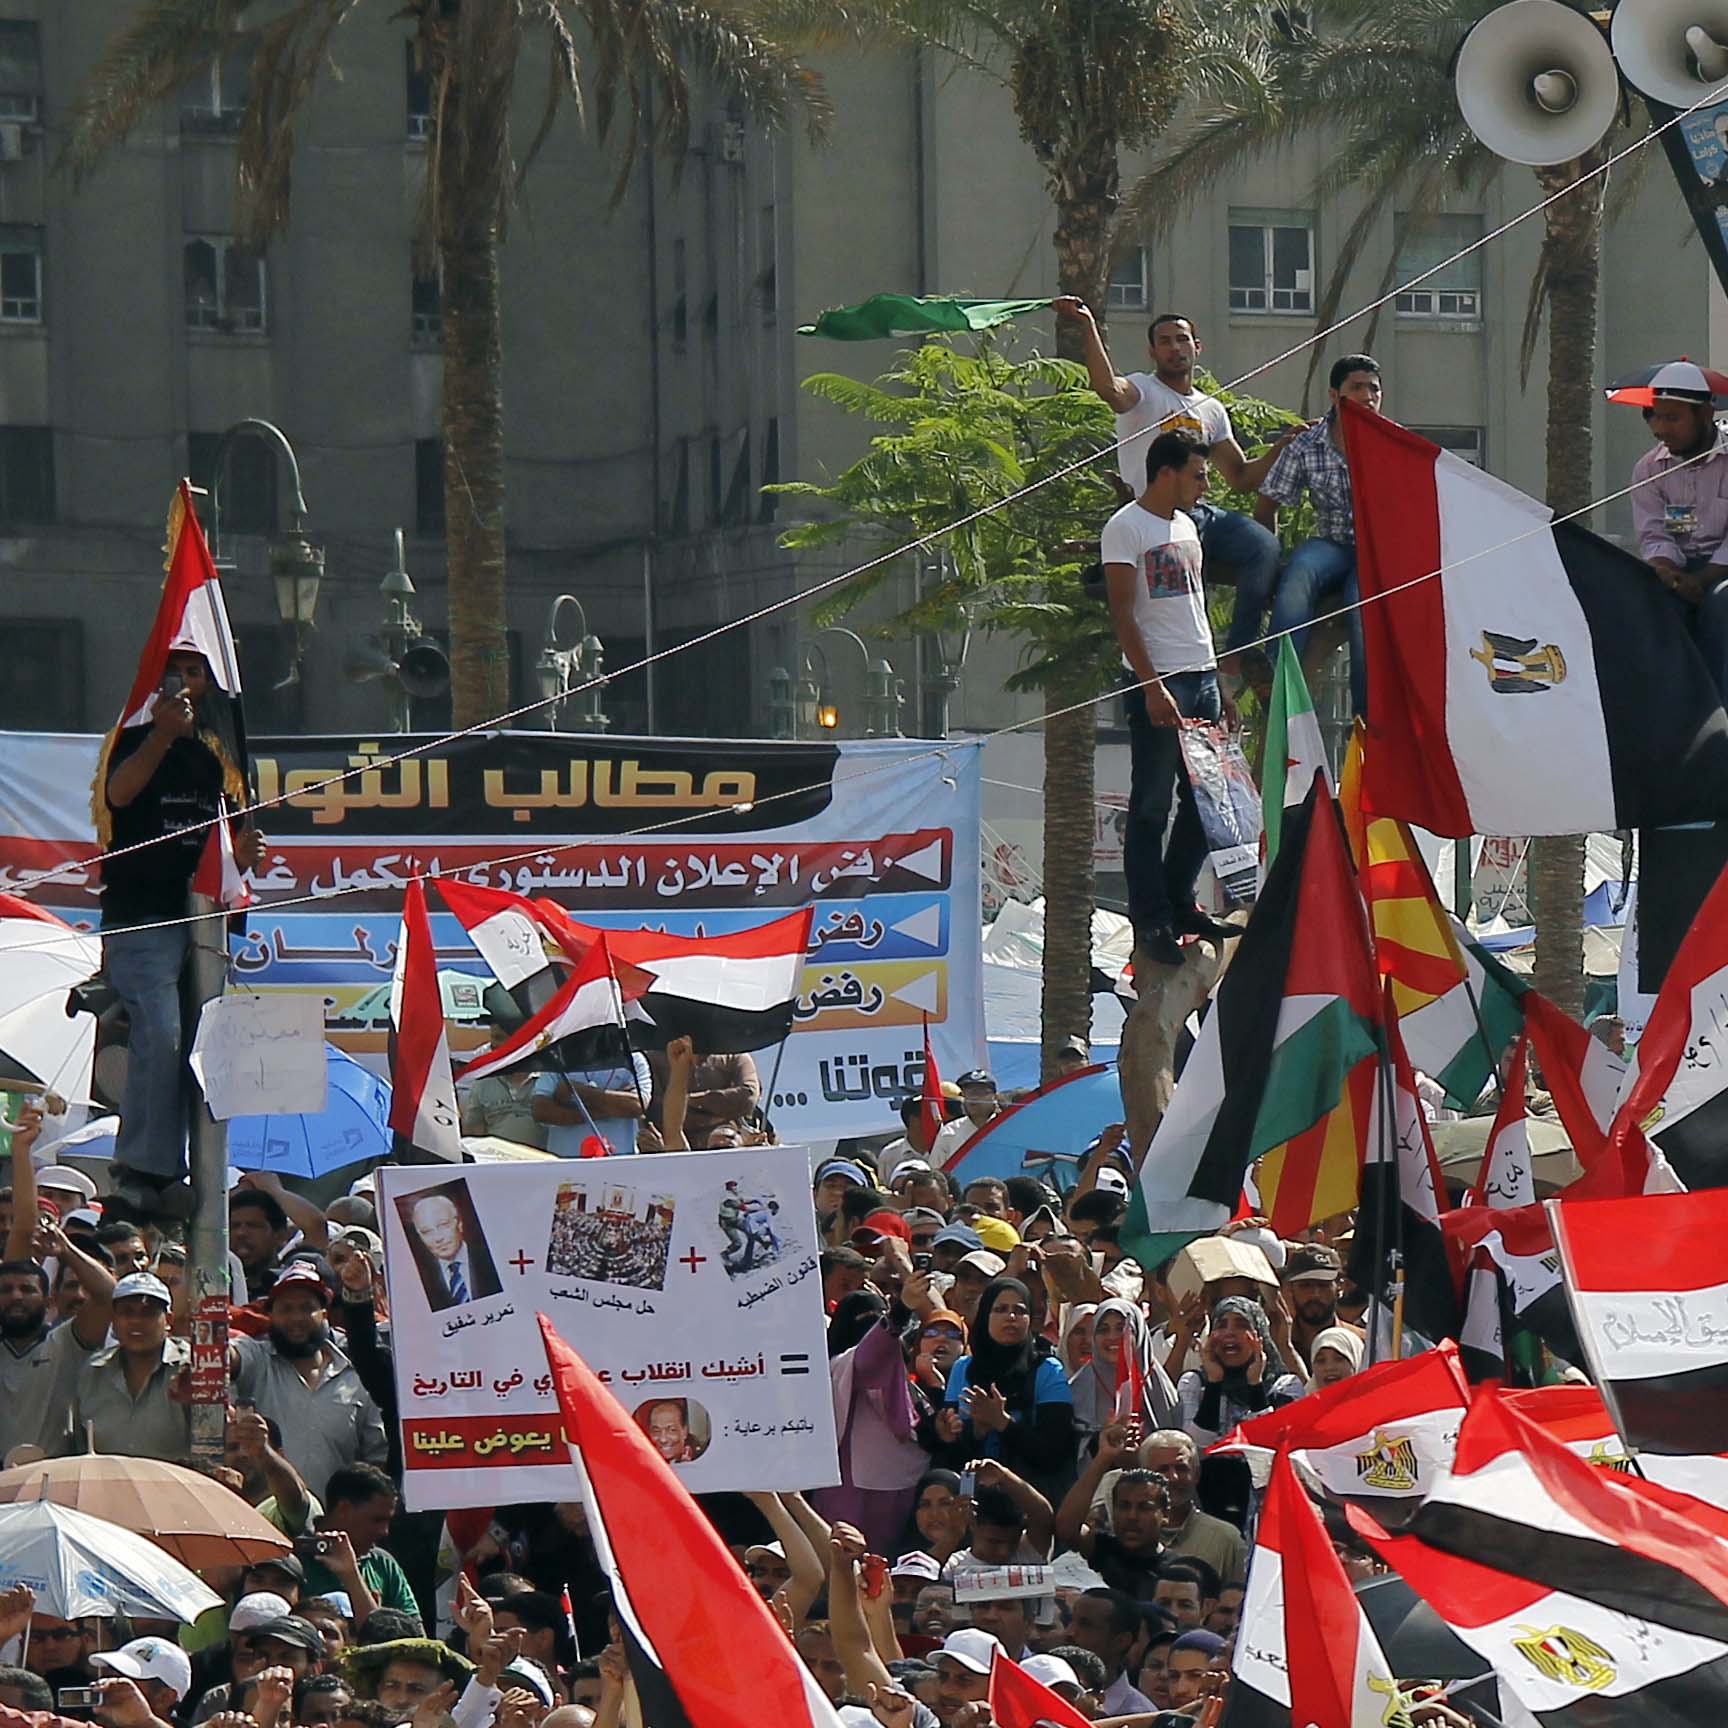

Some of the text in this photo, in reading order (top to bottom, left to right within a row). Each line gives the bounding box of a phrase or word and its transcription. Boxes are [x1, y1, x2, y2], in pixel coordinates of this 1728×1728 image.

[255, 742, 449, 824] الثوا
[484, 757, 757, 823] مطالب
[655, 852, 799, 897] الإعلان
[806, 911, 884, 951] رفض
[796, 972, 884, 1016] رفض
[786, 1255, 819, 1288] قانون
[548, 1284, 656, 1315] حل مجلس الشعب
[441, 1312, 478, 1338] شفيق
[620, 1360, 692, 1383] انقلاب
[701, 1352, 768, 1380] أشيك
[411, 1370, 483, 1398] التاريخ
[492, 1369, 525, 1399] في
[411, 1425, 552, 1456] يعوض علينا
[733, 1417, 776, 1439] برعاية
